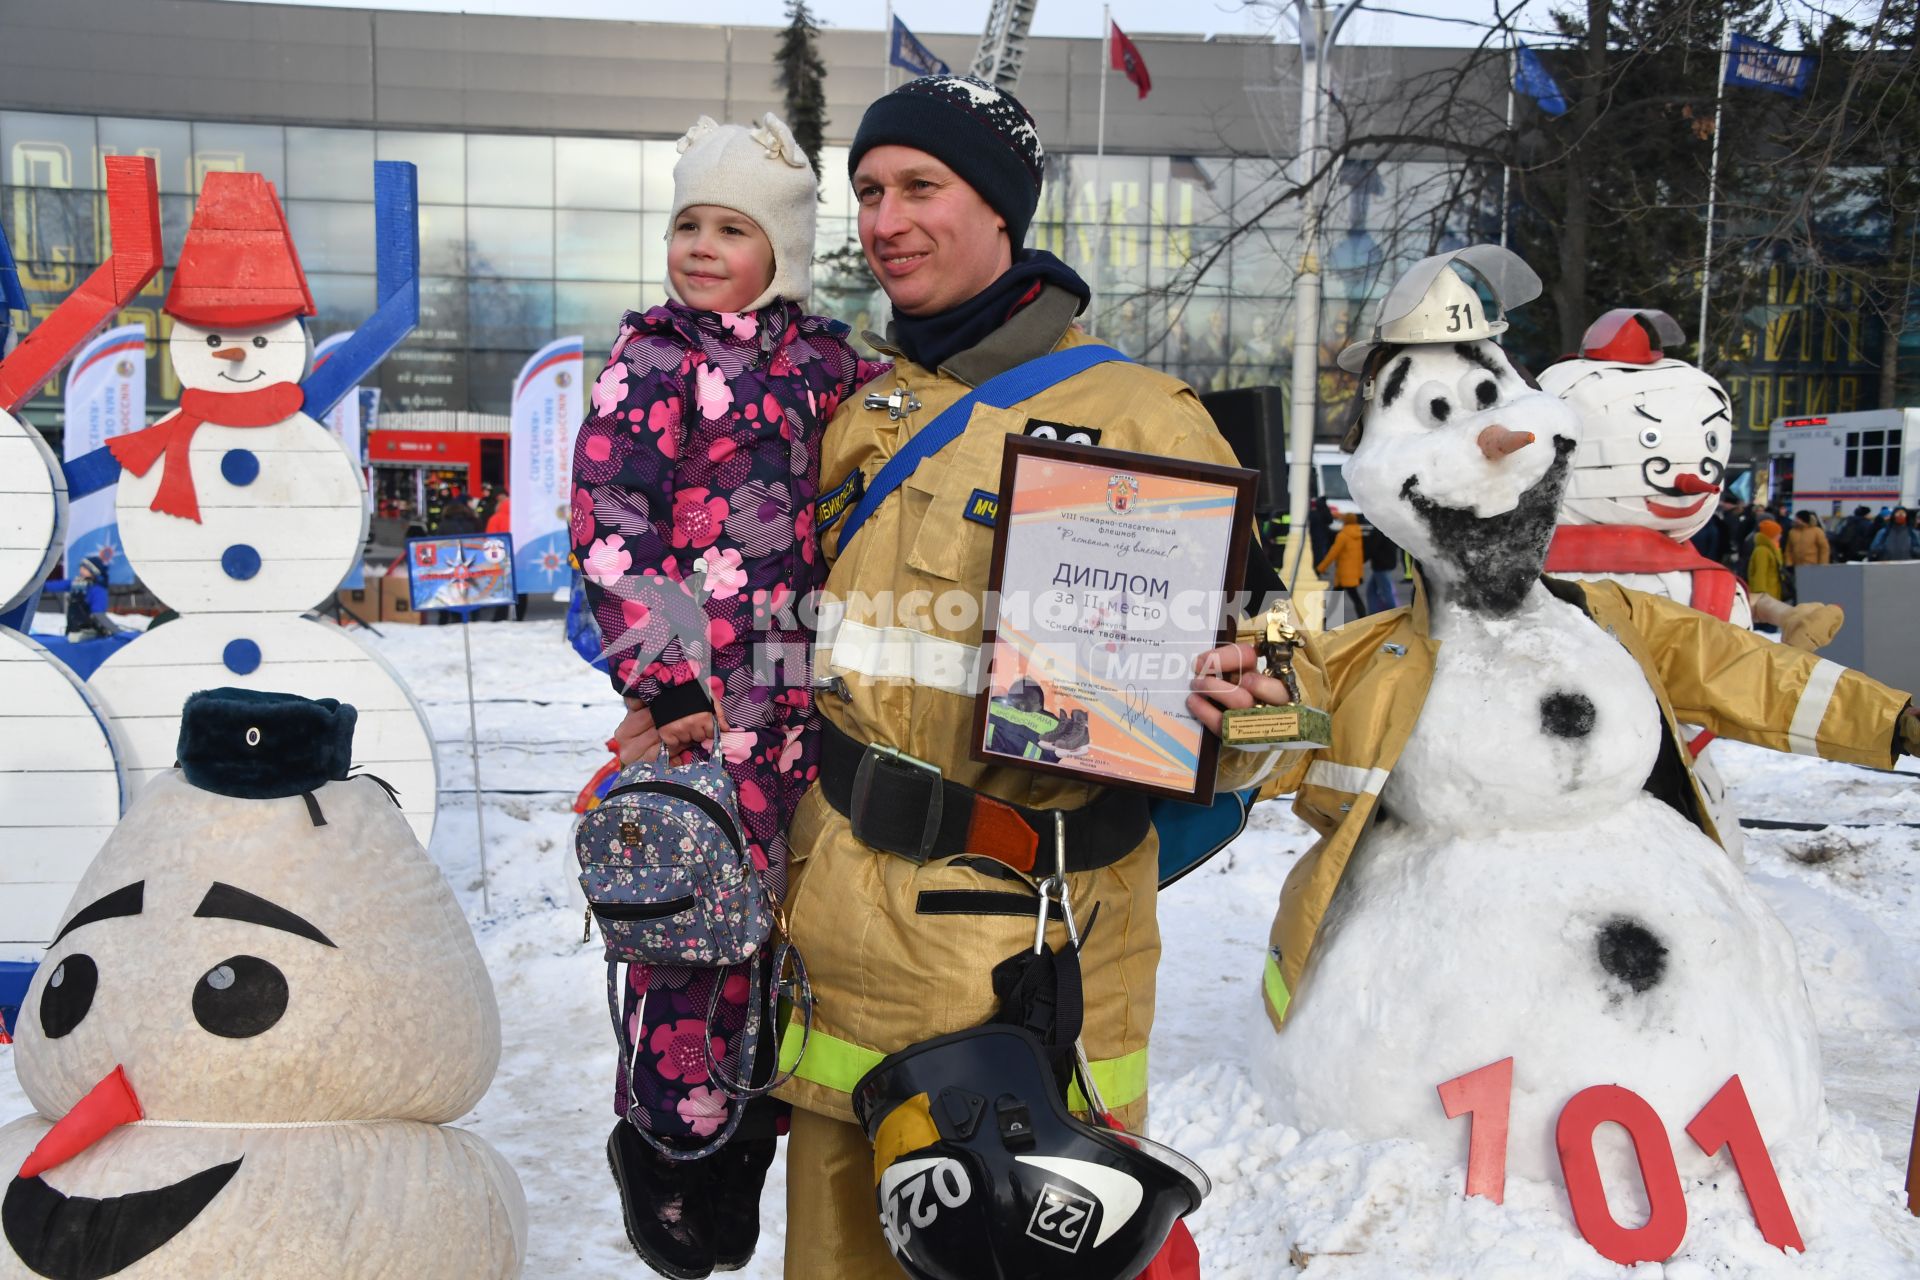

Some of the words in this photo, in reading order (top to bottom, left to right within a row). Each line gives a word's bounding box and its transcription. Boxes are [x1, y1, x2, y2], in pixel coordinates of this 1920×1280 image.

[1446, 303, 1473, 333] 31
[1061, 511, 1077, 520] VIII
[1080, 515, 1177, 536] пожарно-спасательный
[1098, 527, 1136, 539] флешмоб
[1052, 562, 1169, 600] ДИПЛОМ
[1054, 592, 1075, 605] за
[1084, 594, 1099, 608] II
[1107, 601, 1161, 620] место
[1437, 1056, 1805, 1266] 101
